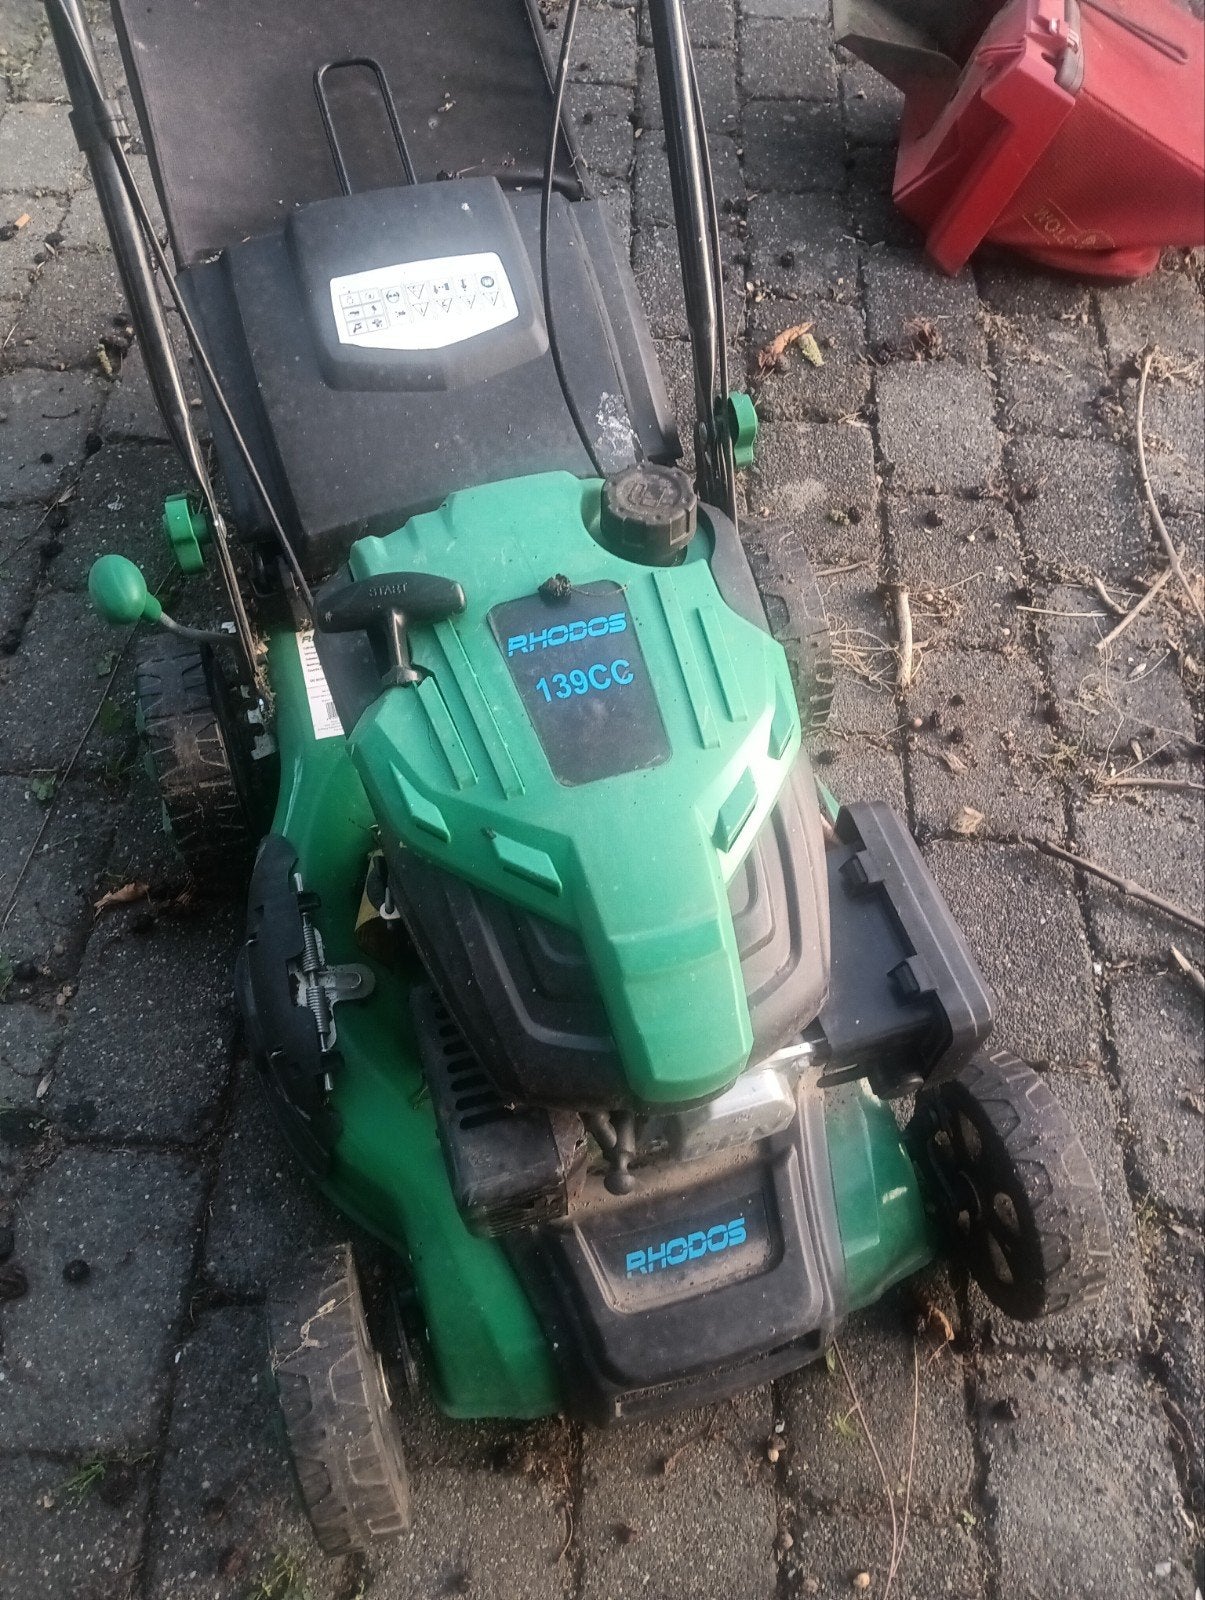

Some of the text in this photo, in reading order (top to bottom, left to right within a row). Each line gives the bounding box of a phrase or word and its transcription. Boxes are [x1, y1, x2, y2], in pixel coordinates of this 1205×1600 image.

[369, 582, 408, 597] START
[508, 612, 627, 657] RHODOS
[535, 659, 634, 703] 139CC
[626, 1217, 747, 1279] RHODOS
